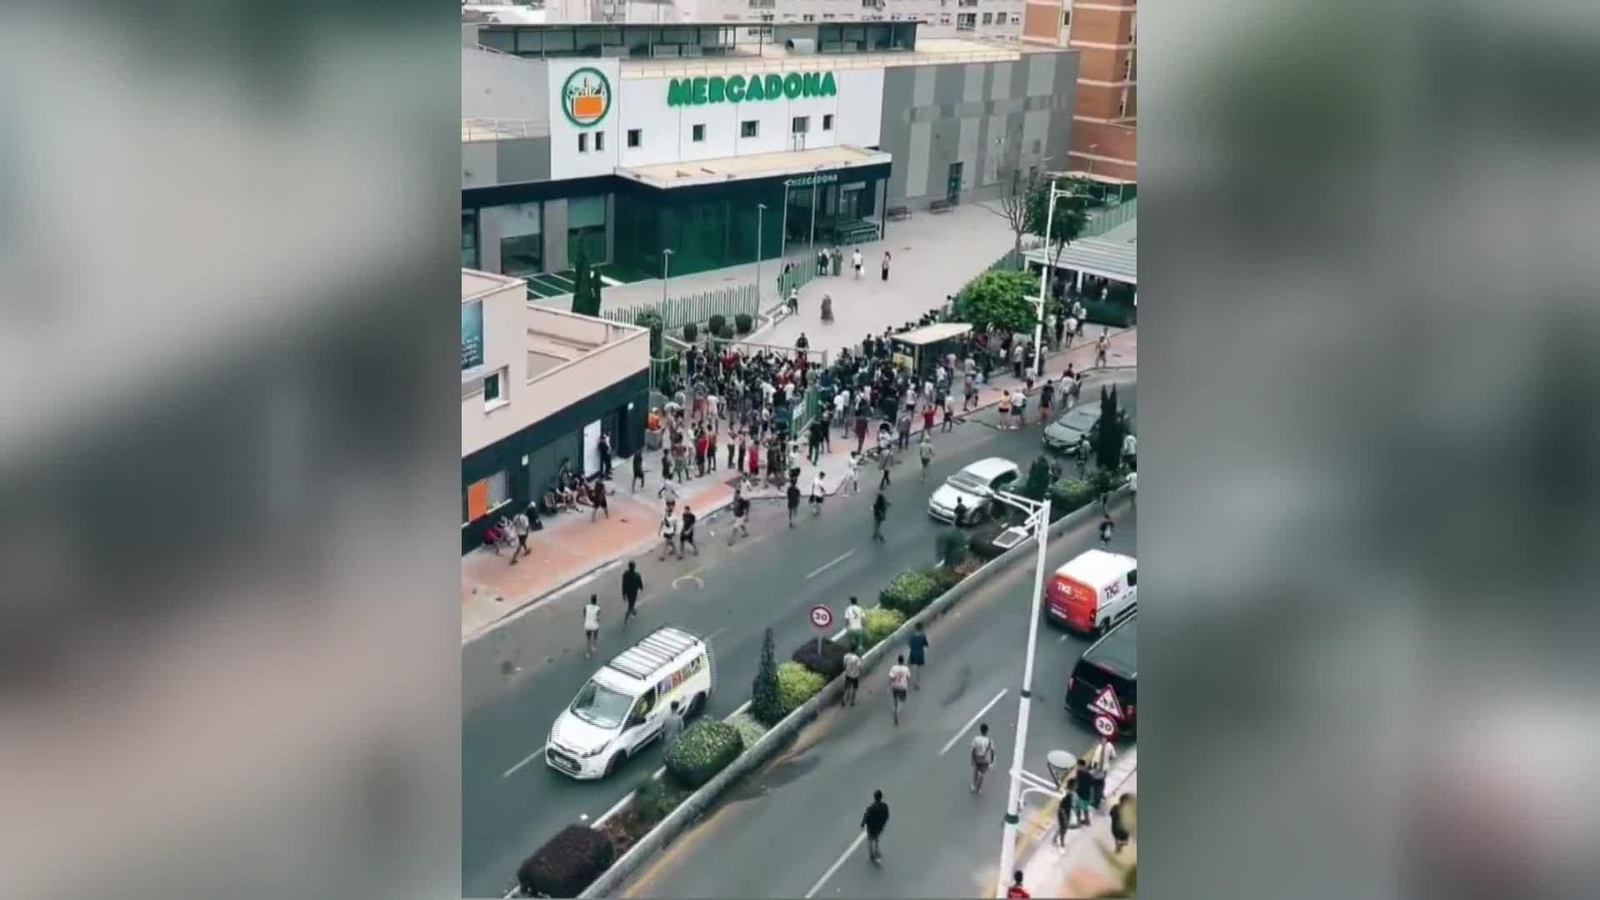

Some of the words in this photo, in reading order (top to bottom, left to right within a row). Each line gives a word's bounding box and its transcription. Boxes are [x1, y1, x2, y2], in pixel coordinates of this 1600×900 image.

[667, 71, 837, 107] MERCADONA
[814, 611, 828, 621] 30
[1099, 720, 1112, 732] 30
